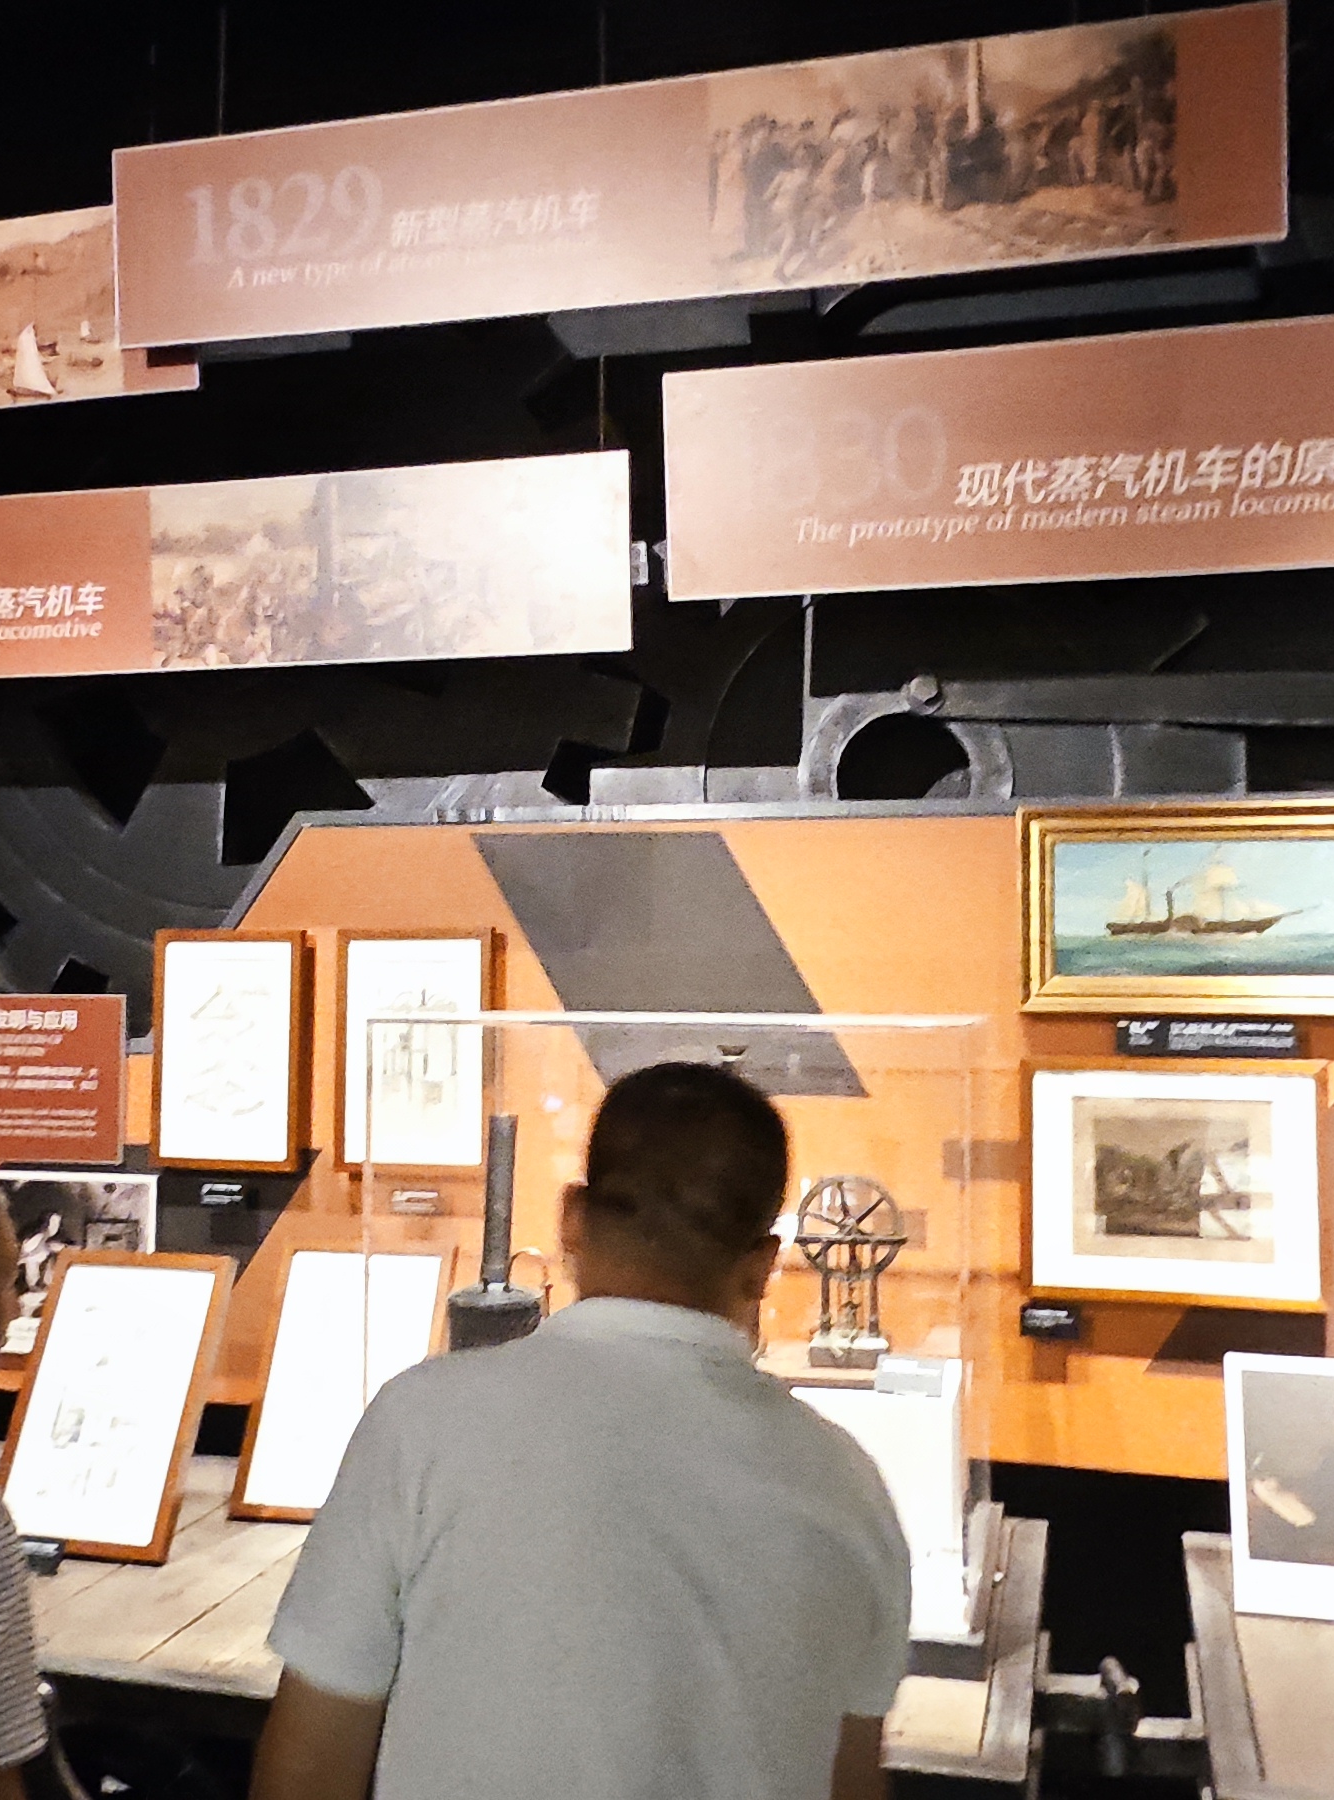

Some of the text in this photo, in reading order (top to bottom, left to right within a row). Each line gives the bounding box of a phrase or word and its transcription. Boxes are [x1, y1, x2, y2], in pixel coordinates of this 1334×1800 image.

[184, 165, 383, 266] 1829
[390, 187, 603, 248] 新型蒸汽机车
[227, 266, 246, 289] A
[252, 264, 295, 286] new
[796, 516, 843, 544] The
[848, 510, 979, 548] prototype
[986, 504, 1017, 534] of
[1021, 502, 1129, 531] modern
[1135, 498, 1221, 524] steam
